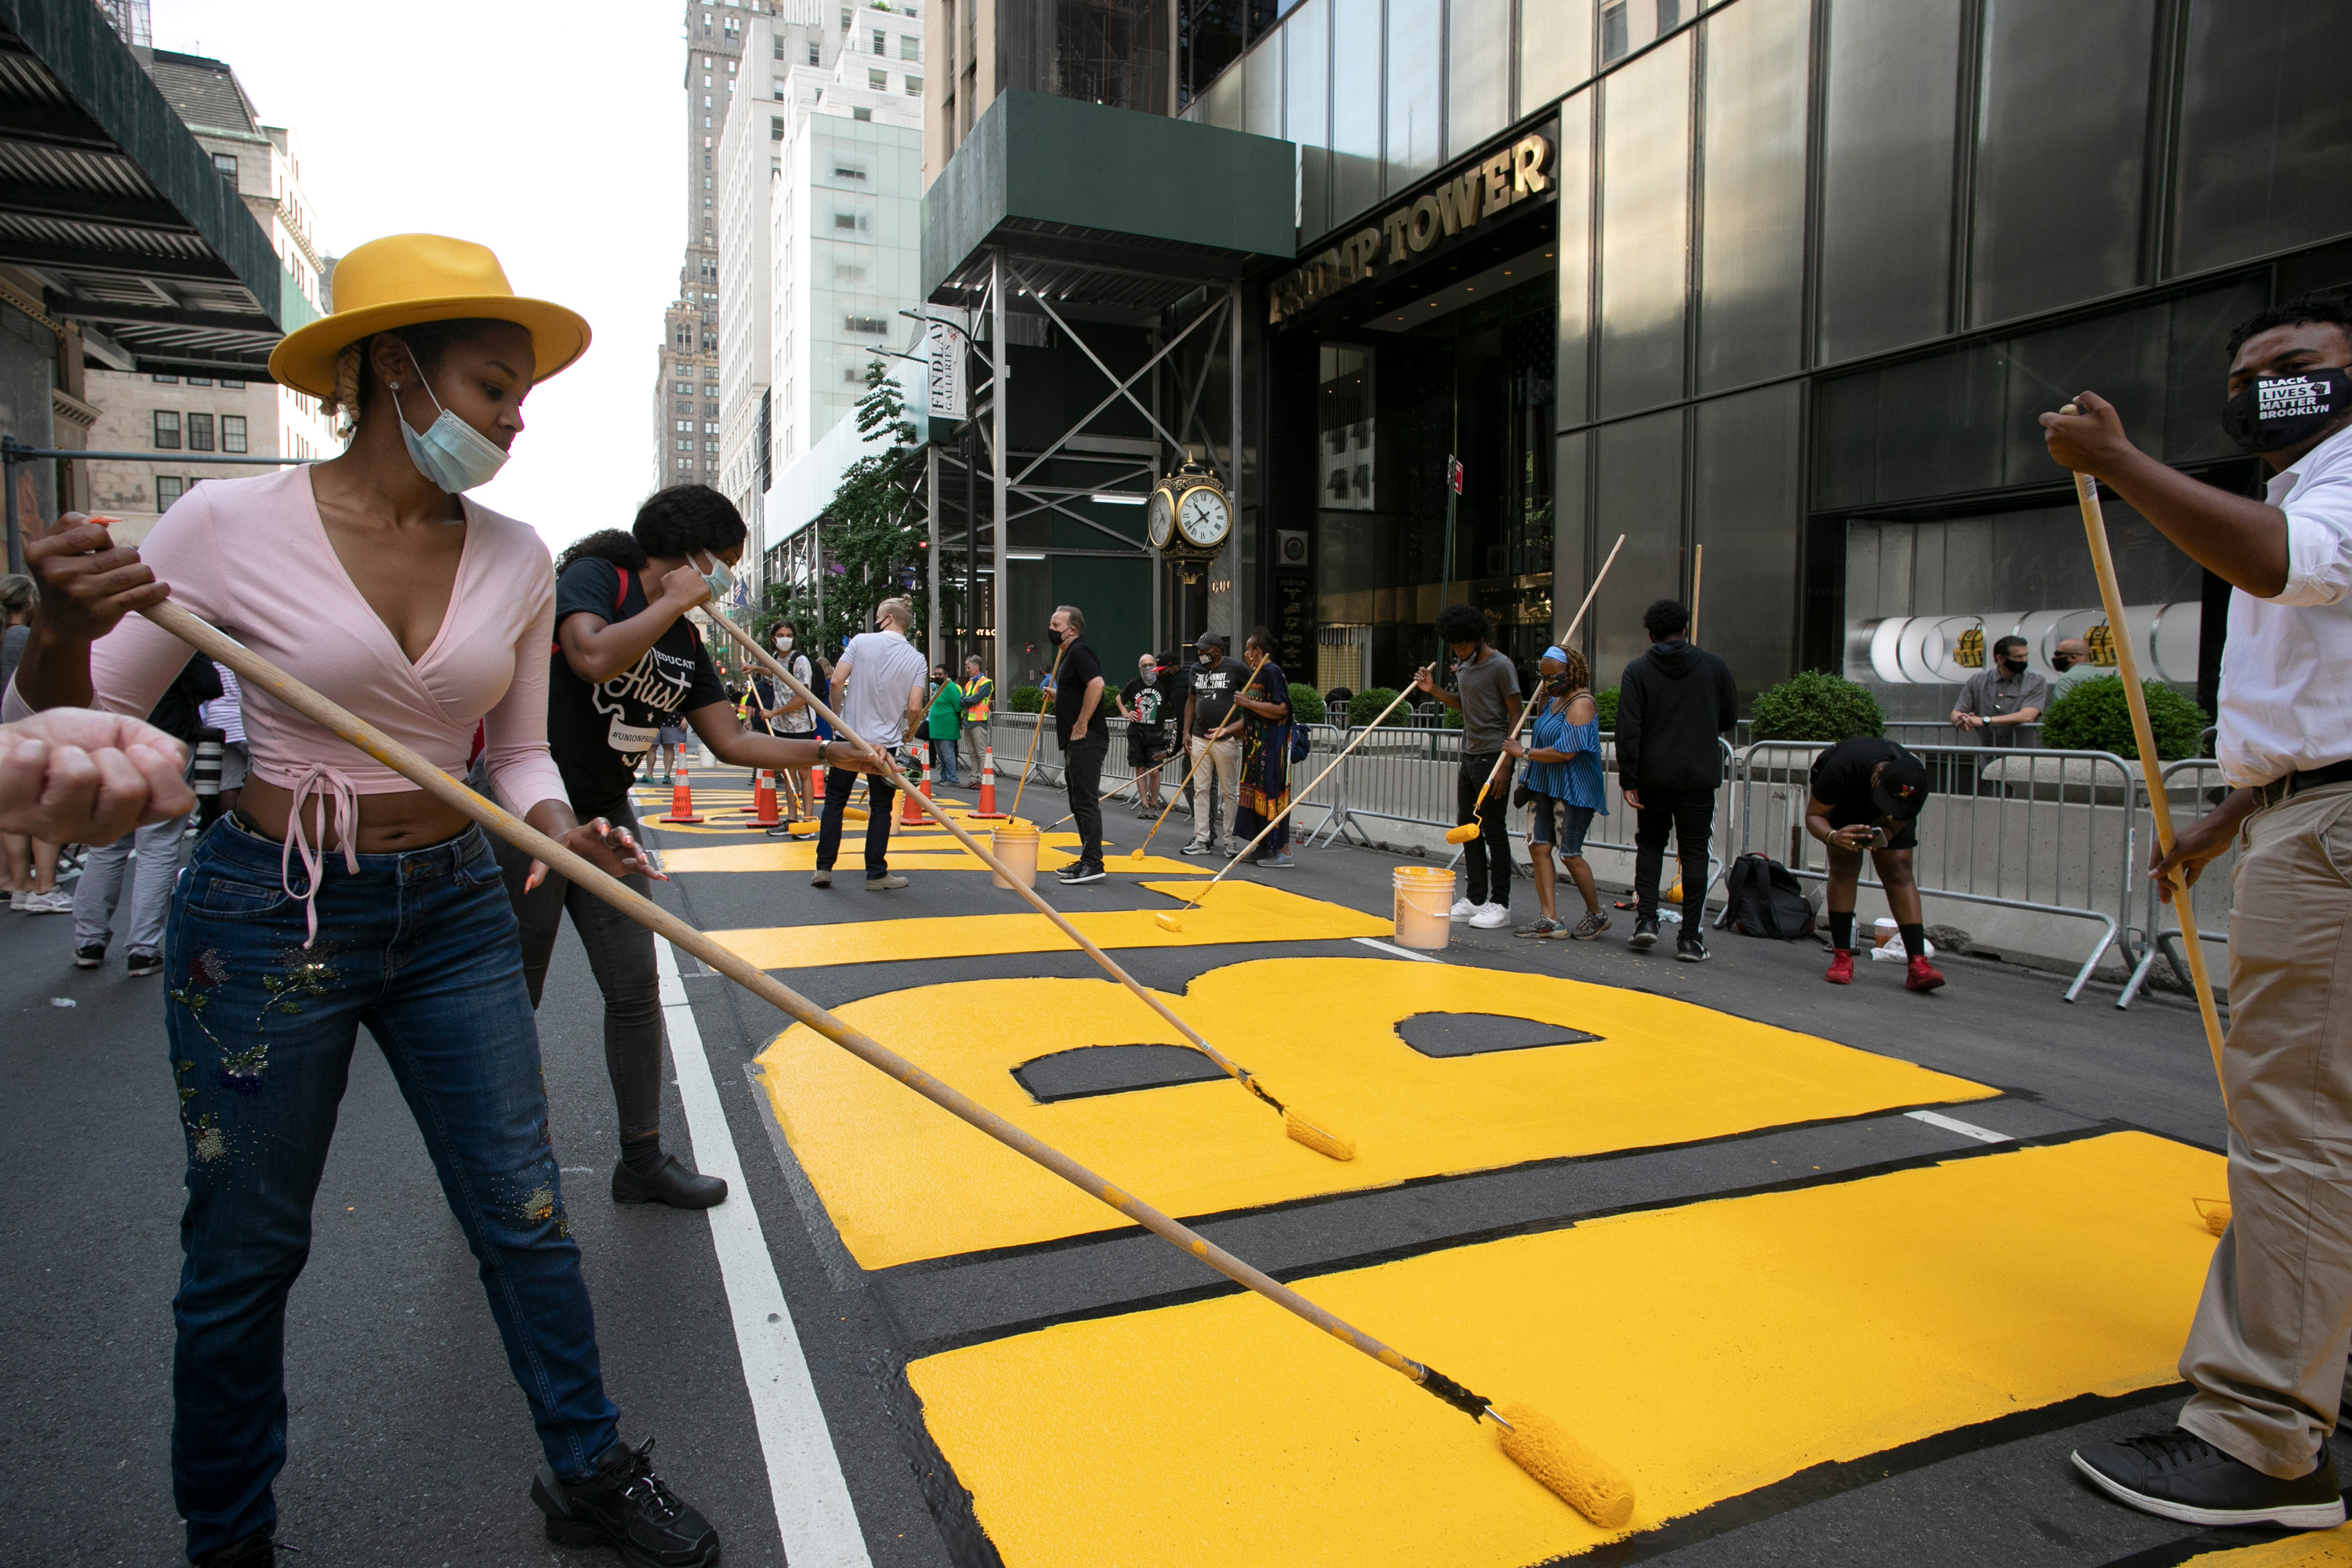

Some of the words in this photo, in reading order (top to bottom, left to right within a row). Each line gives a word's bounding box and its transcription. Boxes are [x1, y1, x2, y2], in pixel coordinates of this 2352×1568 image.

[1269, 227, 1380, 325] TRUMP
[1384, 134, 1555, 266] TOWER
[930, 322, 944, 409] FINDLAY
[2258, 376, 2309, 389] BLACK
[2262, 387, 2307, 401] LIVES
[2259, 396, 2317, 411] MATTER
[2259, 404, 2330, 420] BROOKLYN
[1185, 478, 1203, 487] TRUMP
[1203, 477, 1221, 488] TOWER
